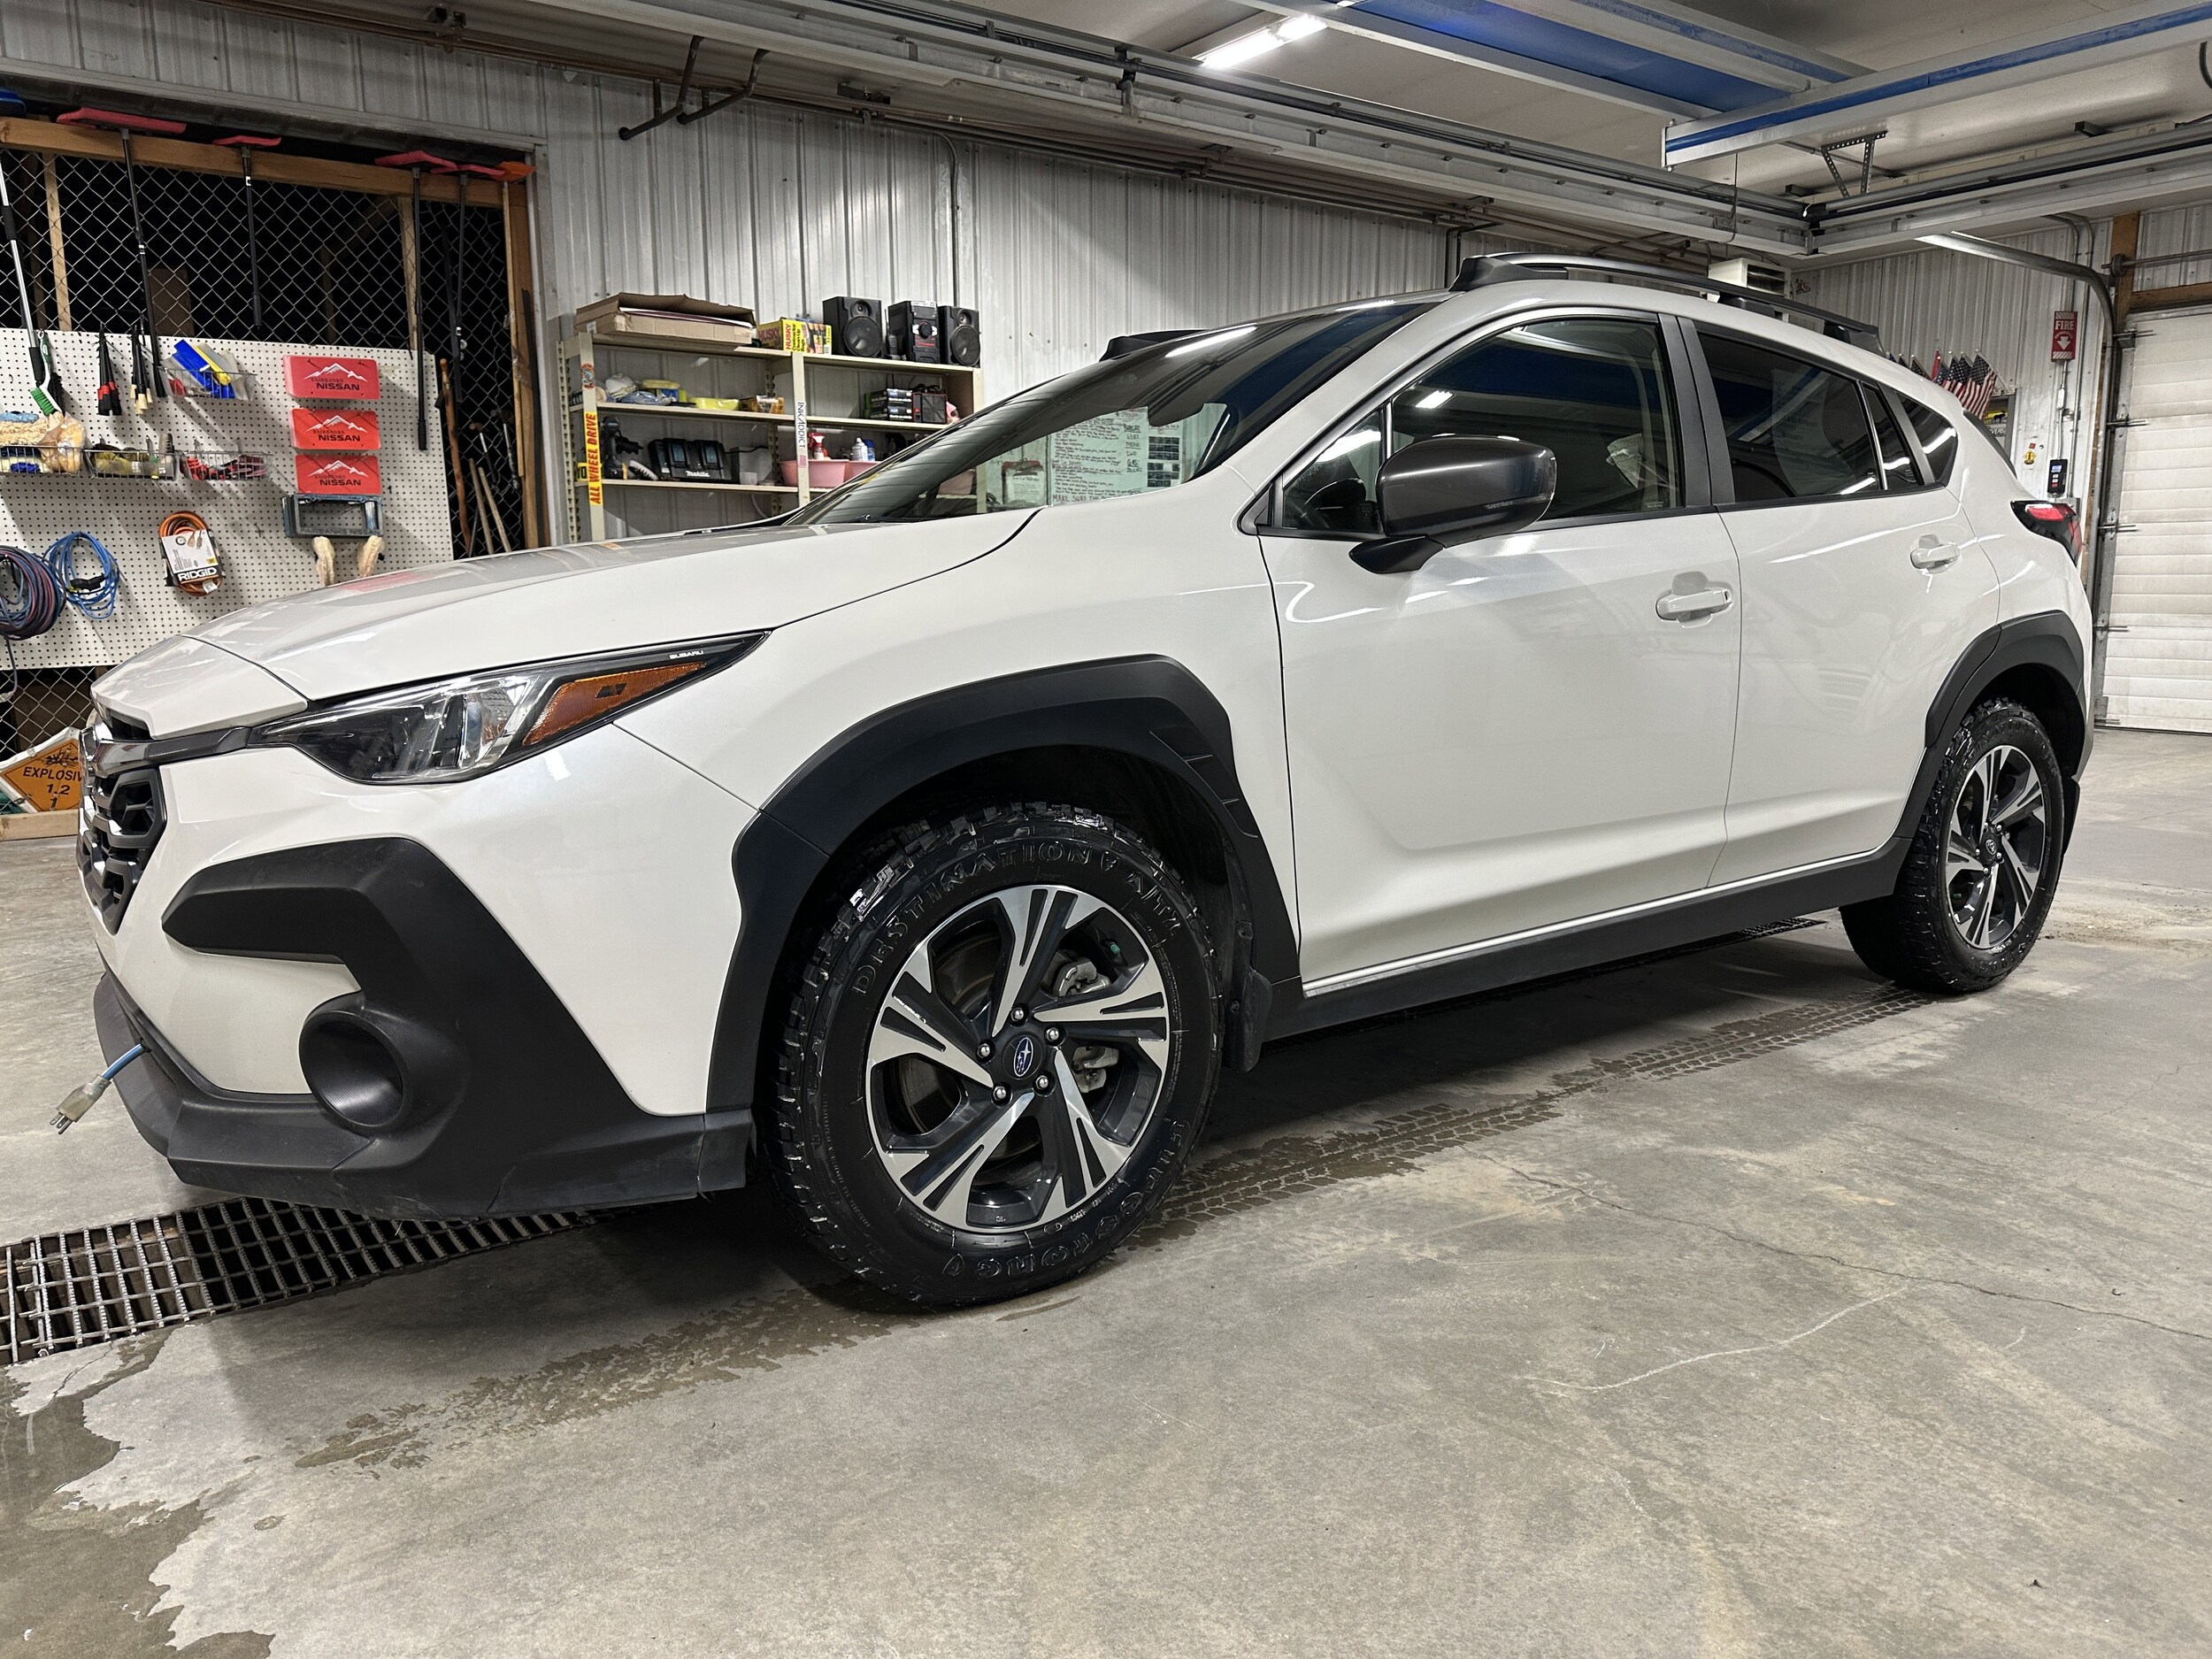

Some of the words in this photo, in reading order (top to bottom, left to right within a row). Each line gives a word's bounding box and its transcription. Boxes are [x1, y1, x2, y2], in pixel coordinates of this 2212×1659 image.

[2055, 320, 2075, 330] FIRE
[316, 382, 360, 391] NISSAN
[586, 412, 597, 445] DRIVE
[318, 434, 361, 442] NISSAN
[588, 449, 599, 483] WHEEL
[589, 486, 601, 504] ALL
[177, 567, 218, 581] RIDGID
[669, 649, 704, 660] SUBARU
[23, 766, 82, 782] EXPLOSIV
[46, 783, 71, 795] 1.2
[850, 841, 1094, 995] DESTINATION
